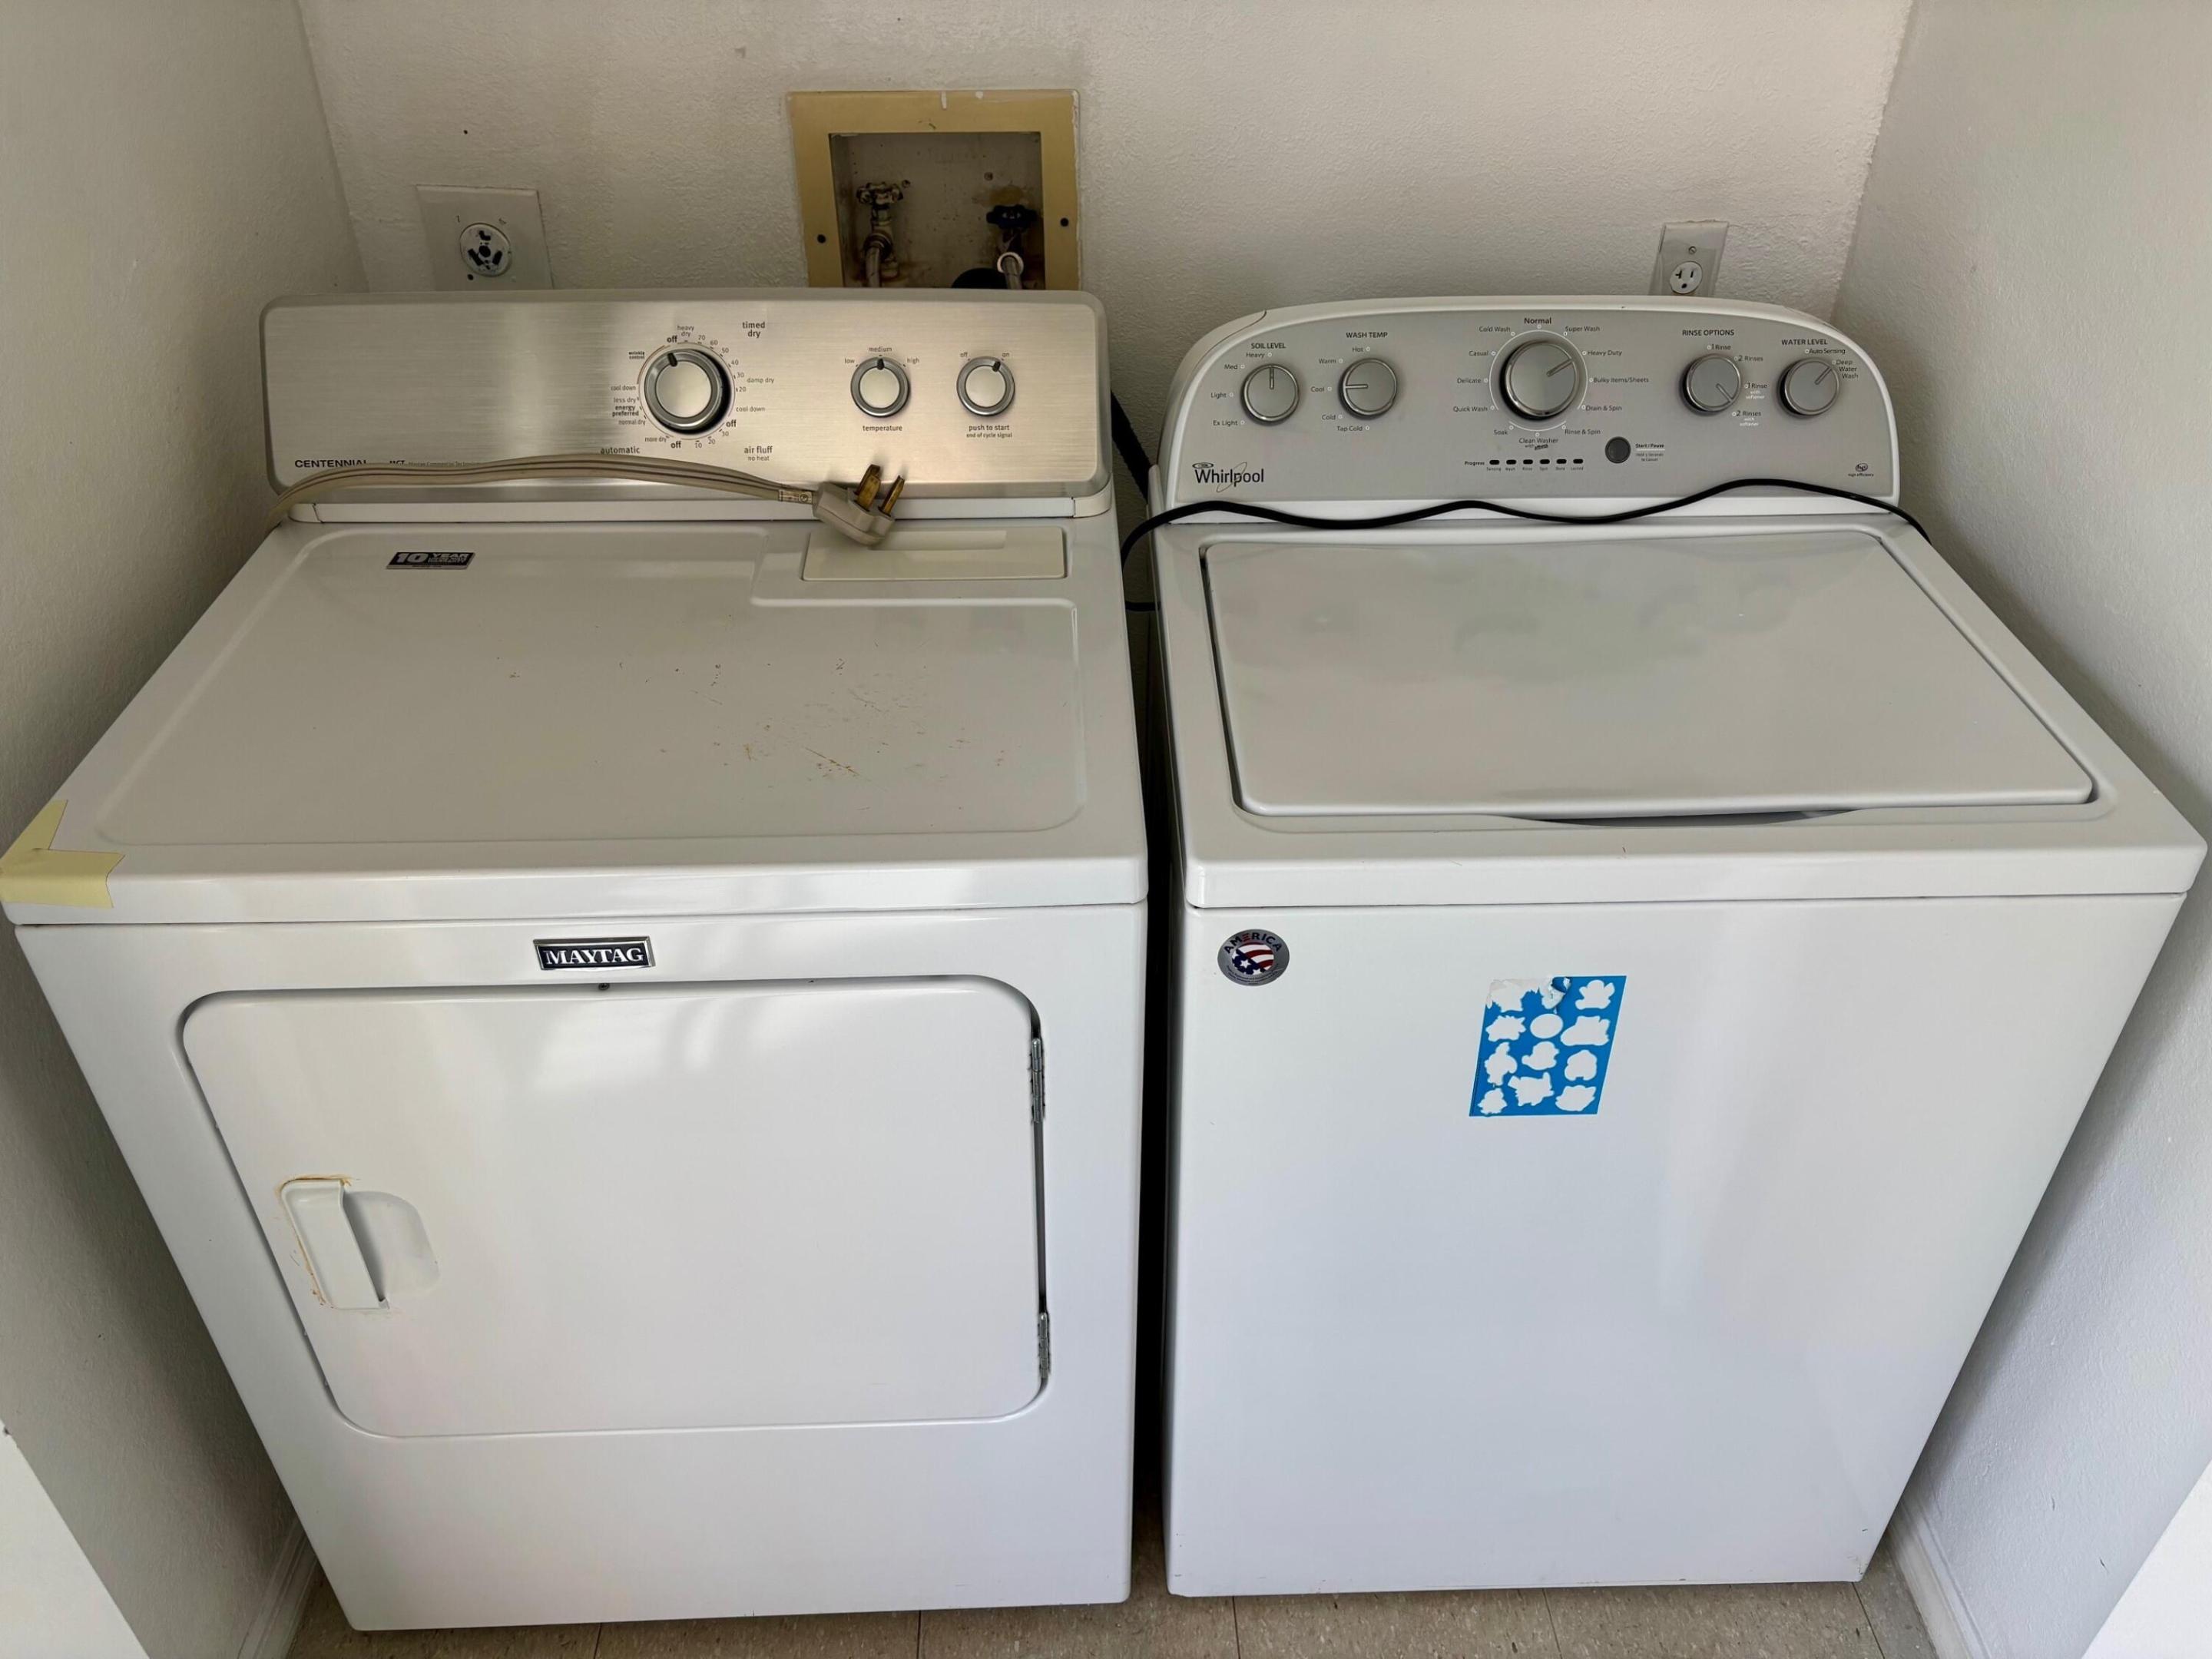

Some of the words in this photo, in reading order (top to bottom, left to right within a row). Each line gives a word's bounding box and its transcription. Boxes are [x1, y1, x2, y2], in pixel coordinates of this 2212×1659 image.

[747, 329, 761, 338] dry
[667, 335, 677, 343] off
[1594, 376, 1613, 385] Bulky
[726, 419, 737, 428] off
[969, 424, 985, 432] push
[671, 441, 681, 449] off
[757, 445, 773, 454] fluff
[1194, 469, 1264, 487] Whirlpool
[396, 553, 429, 563] 10
[1224, 932, 1282, 954] AMERICA
[543, 948, 644, 965] MAYTAG
